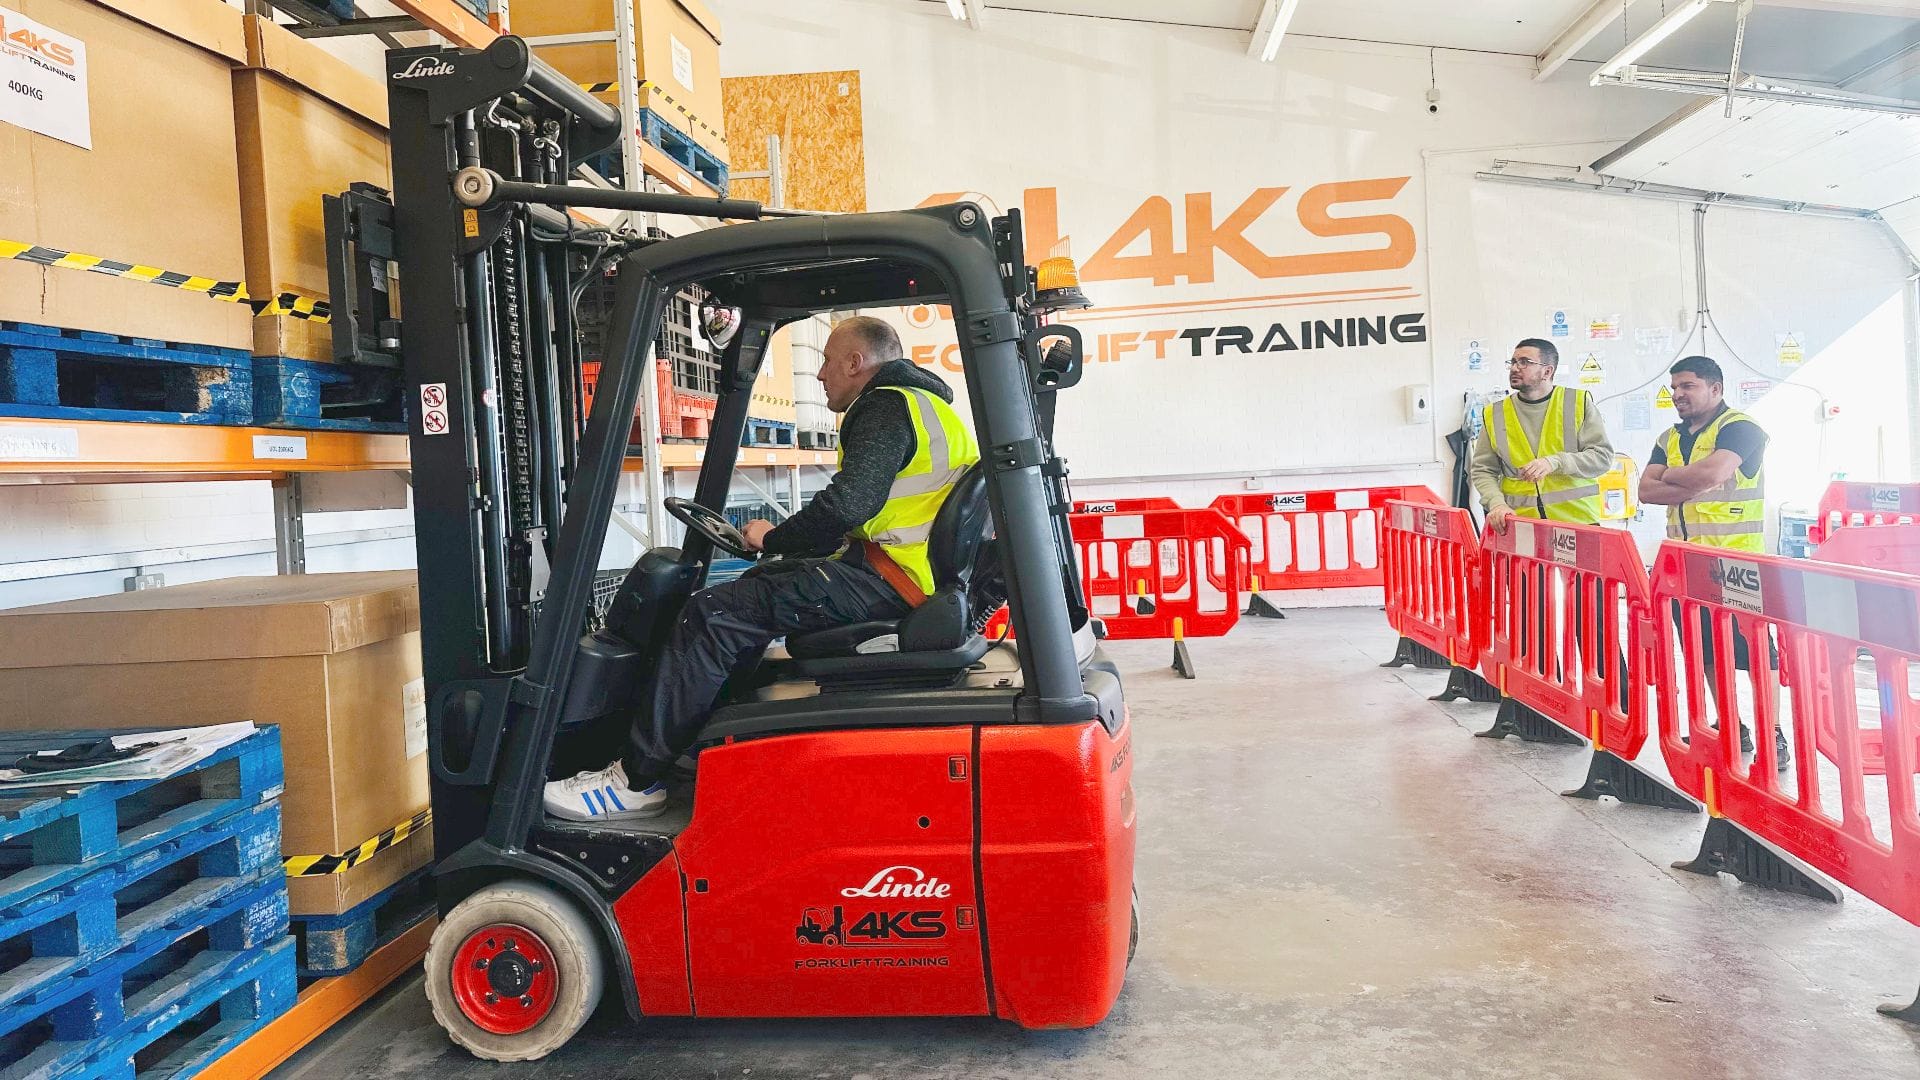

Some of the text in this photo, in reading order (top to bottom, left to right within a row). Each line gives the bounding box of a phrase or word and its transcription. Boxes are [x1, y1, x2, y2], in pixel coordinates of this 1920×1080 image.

[9, 28, 75, 66] 4KS
[392, 56, 455, 79] Linde
[8, 79, 43, 101] 400KG
[1079, 176, 1417, 287] 4KS
[1090, 505, 1115, 513] 4KS
[1279, 496, 1304, 504] 4KS
[1726, 565, 1760, 591] 4KS
[840, 865, 951, 898] Linde
[849, 910, 947, 939] 4KS
[795, 956, 949, 970] FORKLIFTTRAINING
